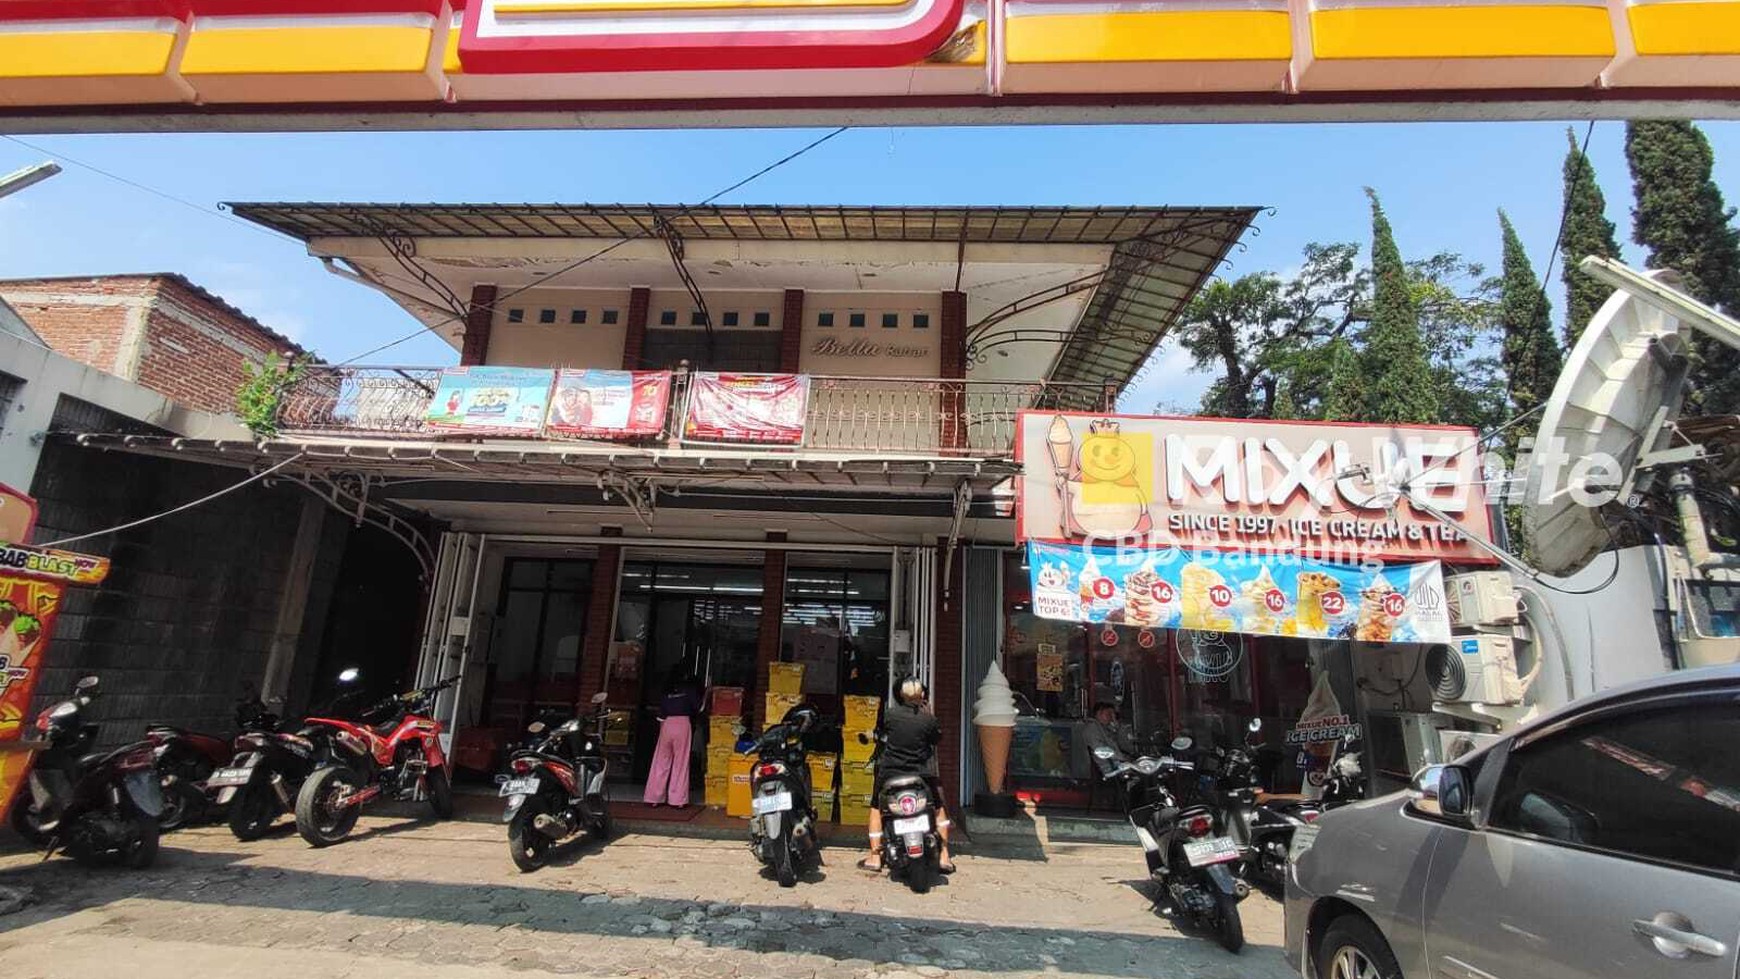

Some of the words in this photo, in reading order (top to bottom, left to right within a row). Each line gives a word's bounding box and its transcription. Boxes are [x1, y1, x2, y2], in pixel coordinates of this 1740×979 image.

[1165, 433, 1468, 514] MIXUE
[1169, 513, 1231, 534] SINCE
[1235, 516, 1277, 535] 1997
[1290, 518, 1322, 536] ICE
[1330, 521, 1401, 540] CREAM
[1407, 524, 1423, 540] &
[1099, 582, 1110, 595] 8
[1153, 586, 1171, 599] 16
[1037, 596, 1070, 607] MIXUE
[1211, 590, 1228, 603] 10
[1267, 594, 1281, 608] 16
[1039, 605, 1059, 614] TOP
[1322, 597, 1342, 610] 22
[1388, 599, 1403, 613] 16
